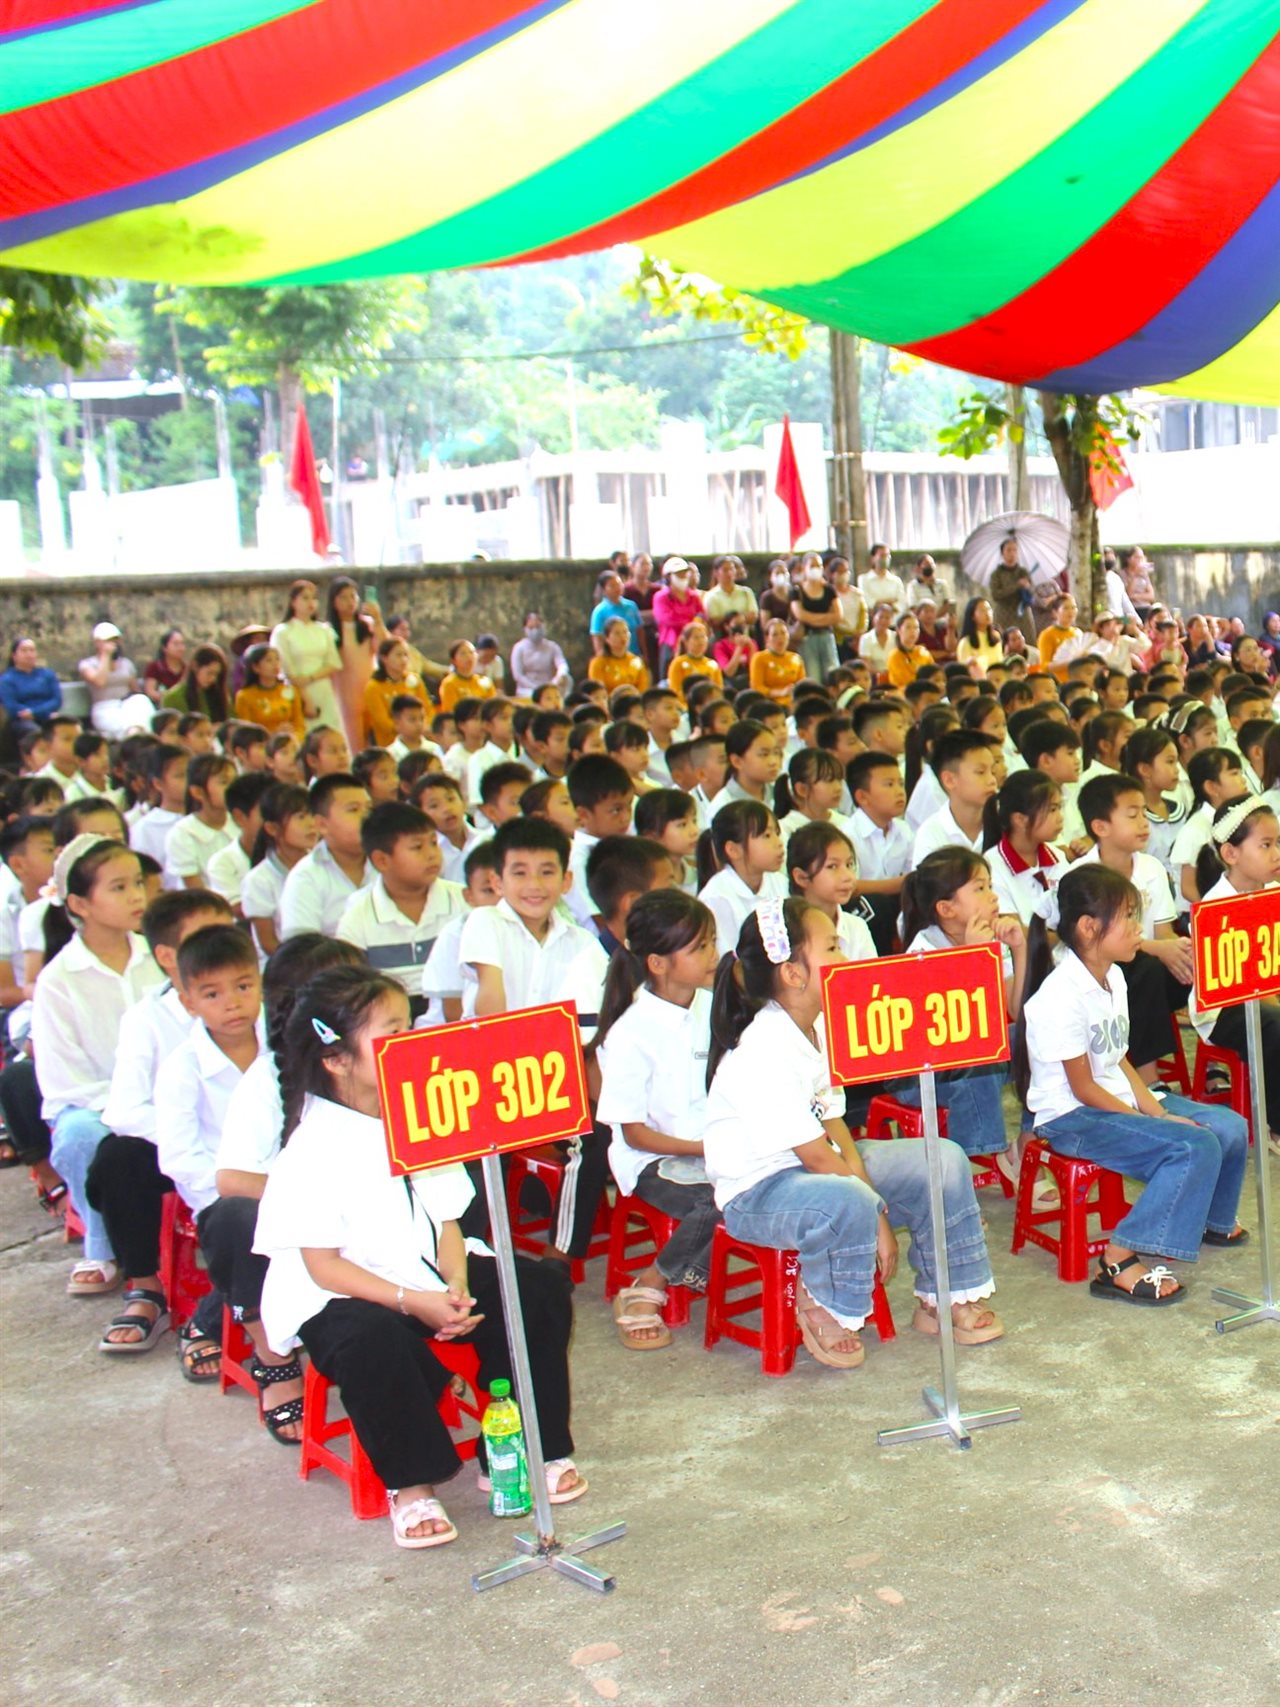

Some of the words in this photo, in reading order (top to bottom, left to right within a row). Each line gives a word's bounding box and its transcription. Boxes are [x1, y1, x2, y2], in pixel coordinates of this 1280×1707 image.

[1204, 916, 1249, 991] LỚP
[846, 984, 912, 1058] LỚP
[926, 987, 988, 1046] 3D1
[402, 1056, 479, 1143] LỚP
[493, 1051, 571, 1124] 3D2
